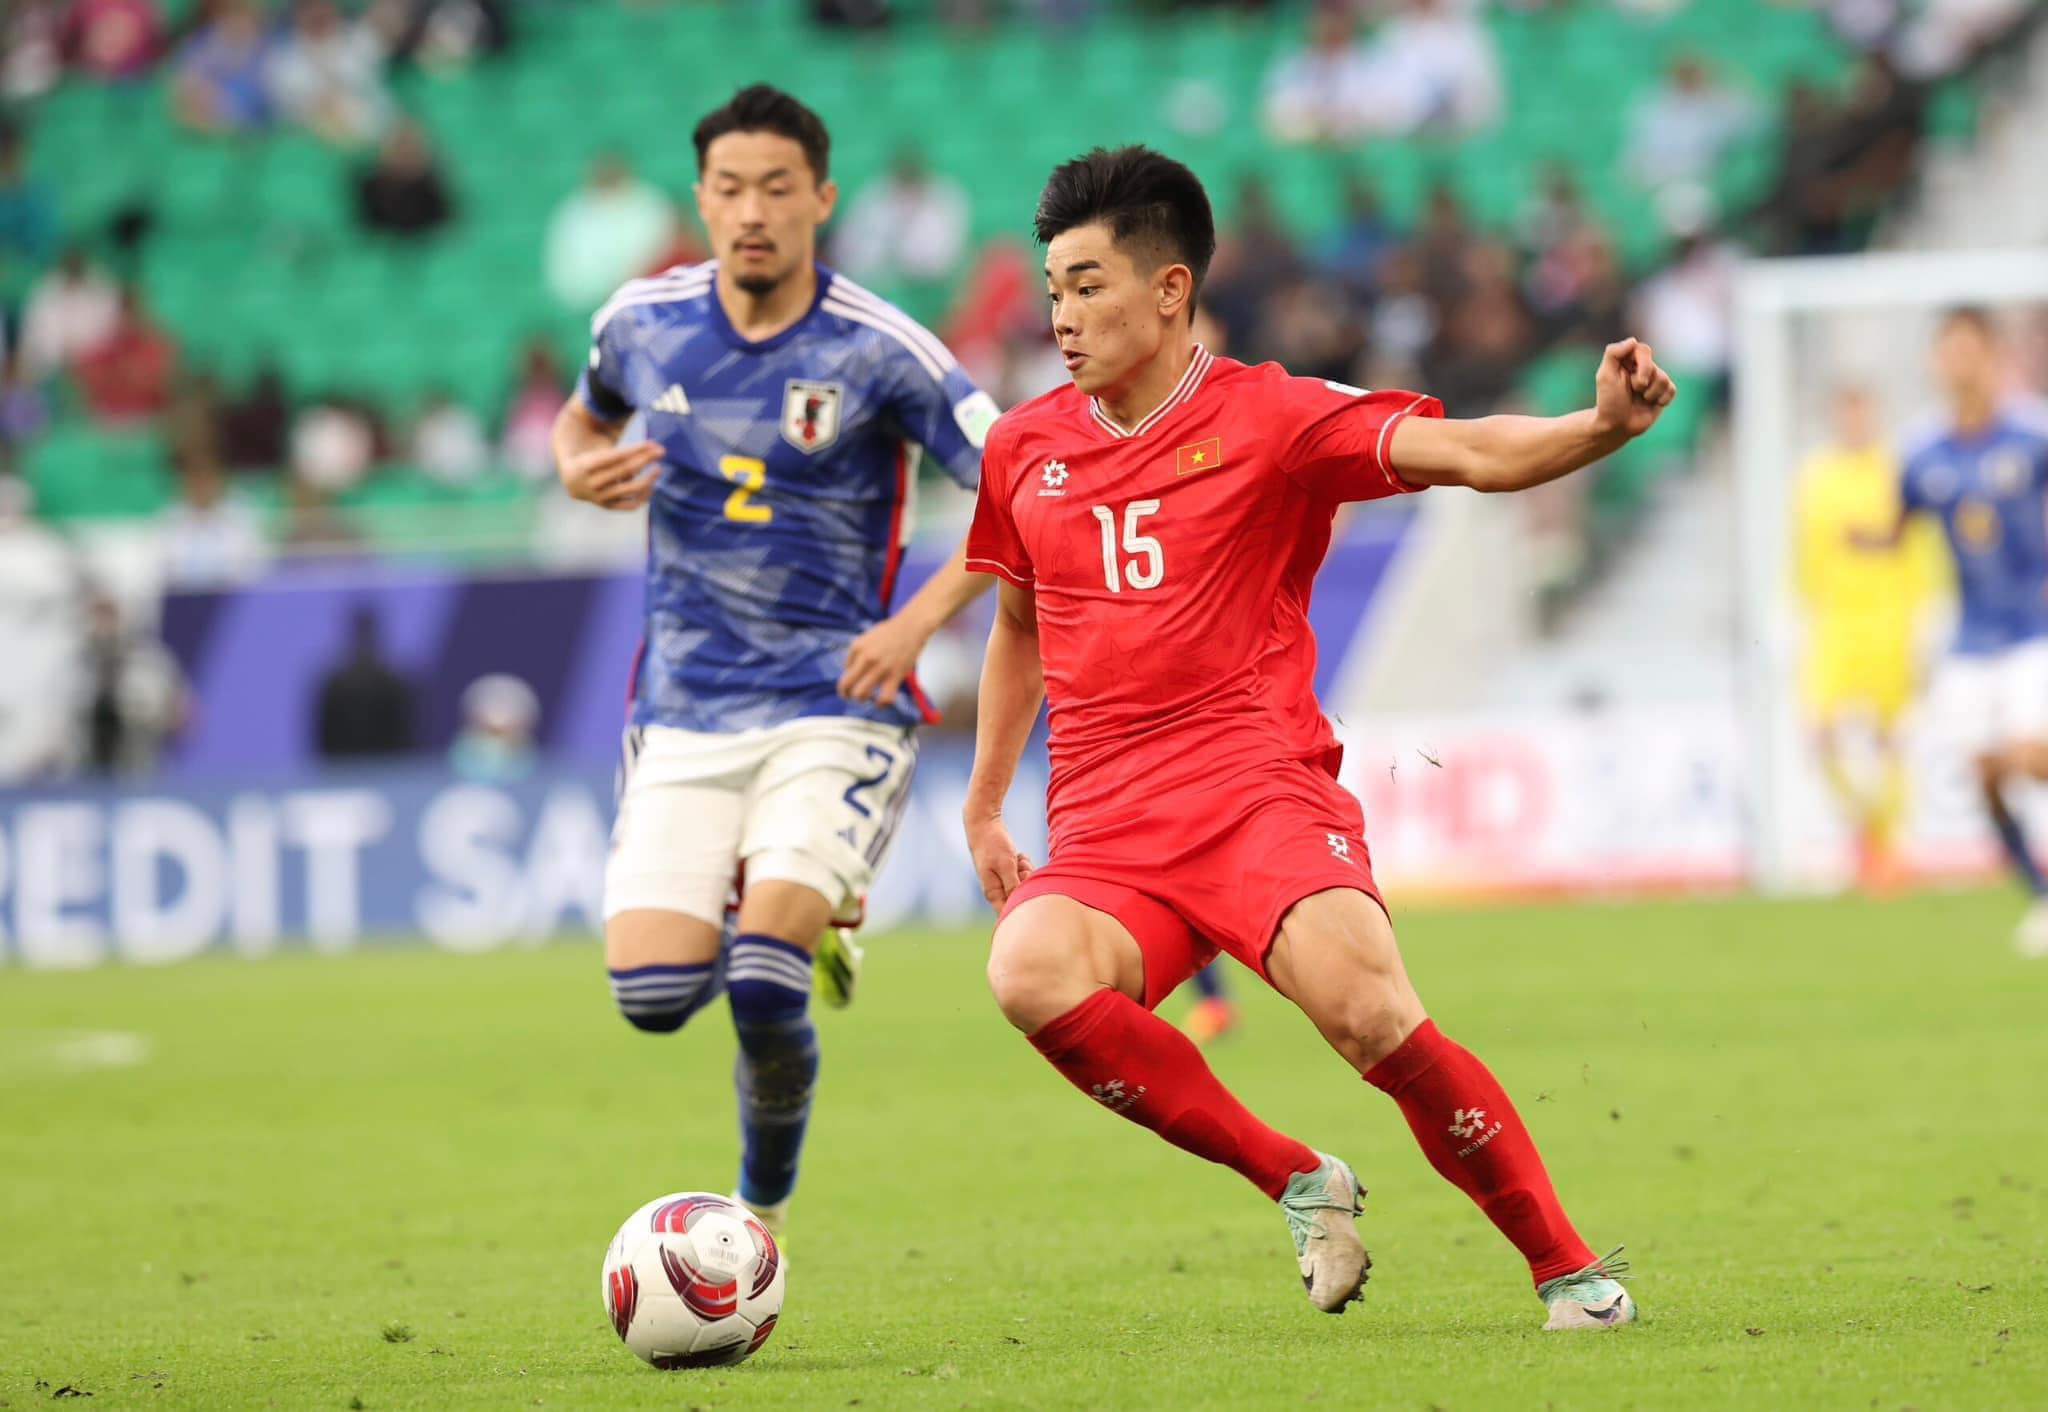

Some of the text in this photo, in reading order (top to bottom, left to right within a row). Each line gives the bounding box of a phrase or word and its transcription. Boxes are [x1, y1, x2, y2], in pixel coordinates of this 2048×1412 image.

[719, 454, 773, 523] 2
[1091, 498, 1165, 593] 15
[844, 744, 894, 818] 2
[0, 792, 392, 964] EDIT
